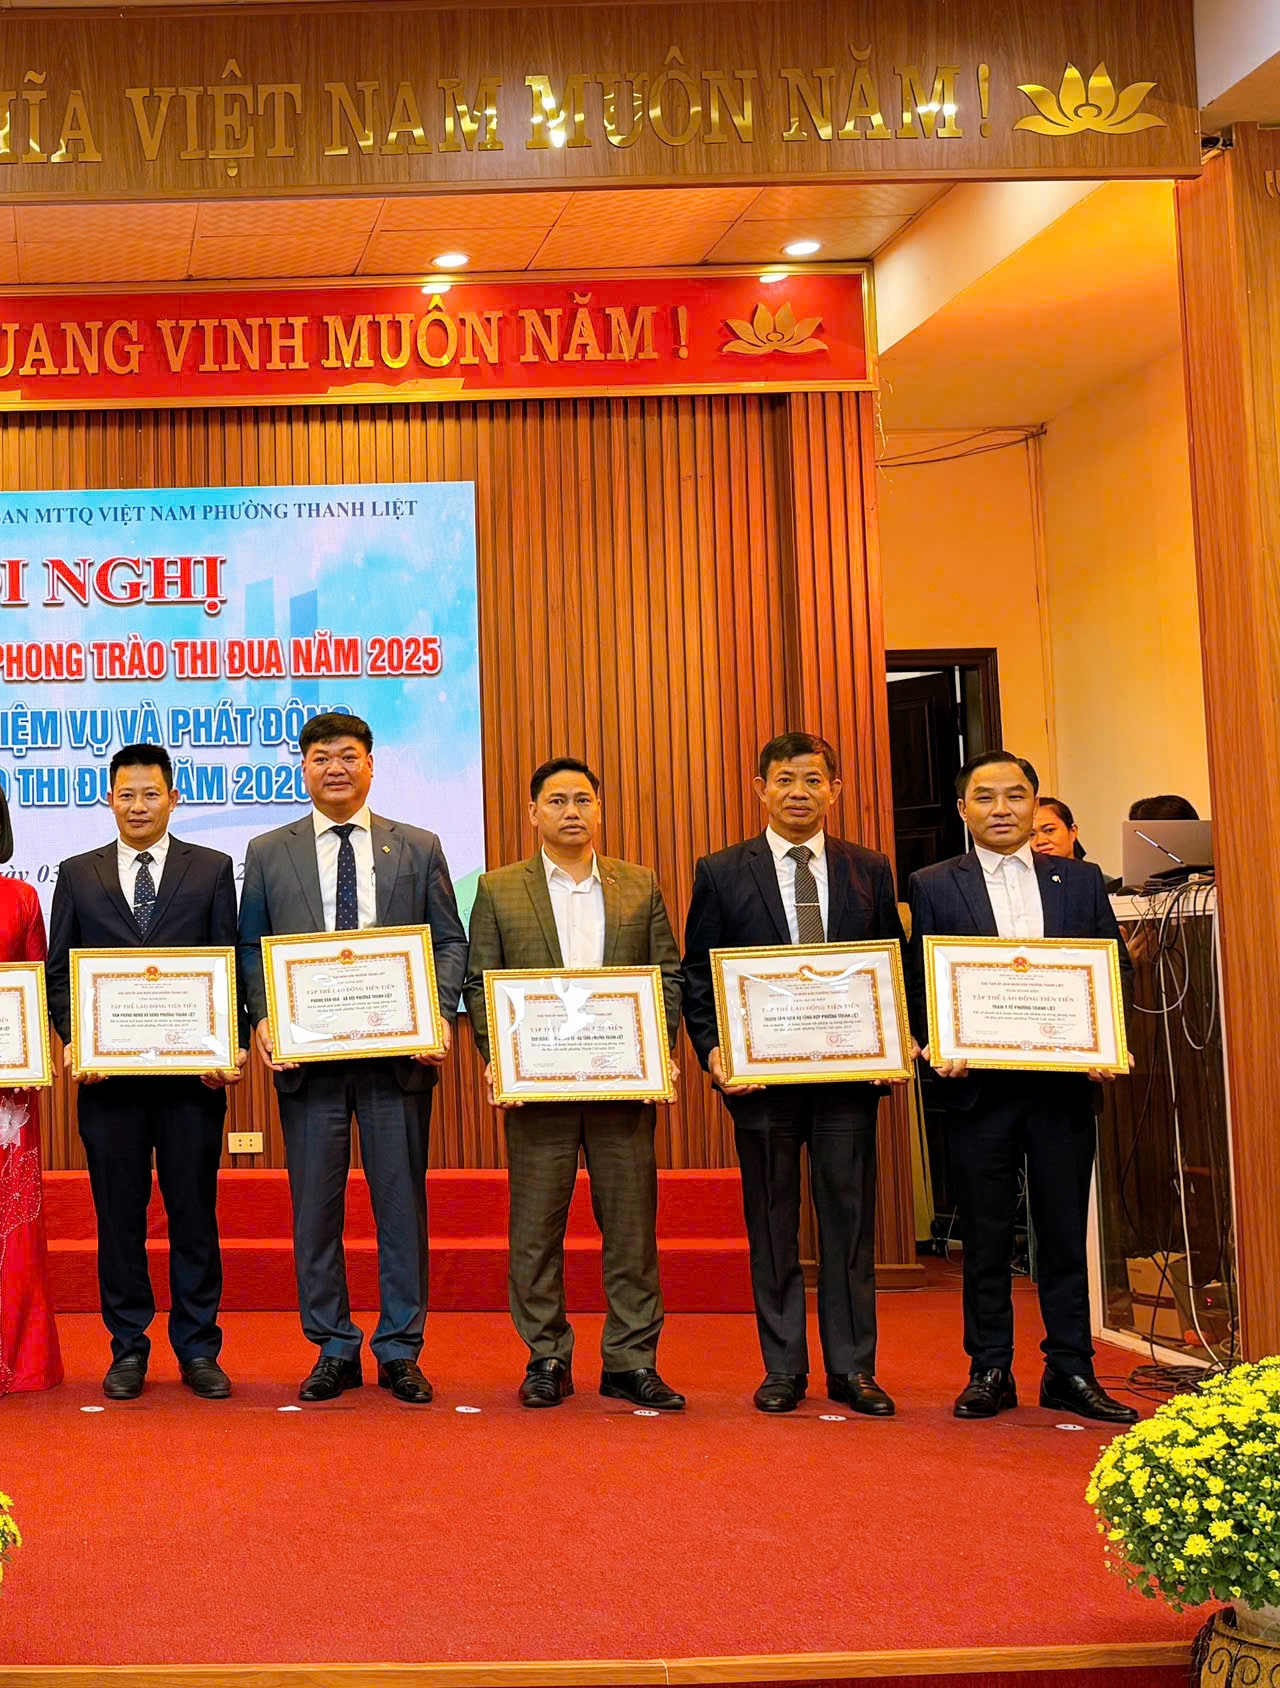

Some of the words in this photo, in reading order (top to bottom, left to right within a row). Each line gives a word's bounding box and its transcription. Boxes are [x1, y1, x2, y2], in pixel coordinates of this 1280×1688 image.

[125, 58, 305, 178] VIỆT
[323, 75, 504, 157] NAM
[525, 45, 757, 150] MUÔN
[157, 316, 310, 373] VINH
[323, 294, 500, 369] MUÔN
[34, 506, 93, 526] MTTQ
[100, 503, 145, 526] VIỆT
[150, 505, 197, 522] NAM
[202, 500, 288, 521] PHƯỜNG
[293, 502, 365, 519] THANH
[370, 499, 418, 521] LIỆT
[43, 555, 226, 614] NGHỊ
[90, 633, 166, 680] TRÀO
[172, 637, 219, 679] THI
[224, 636, 284, 678] ĐUA
[289, 630, 361, 677] NĂM
[367, 635, 442, 676] 2025
[67, 706, 112, 755] VỤ
[117, 700, 164, 746] VÀ
[170, 698, 254, 748] PHÁT
[15, 767, 68, 807] THI
[173, 757, 227, 806] ĂM
